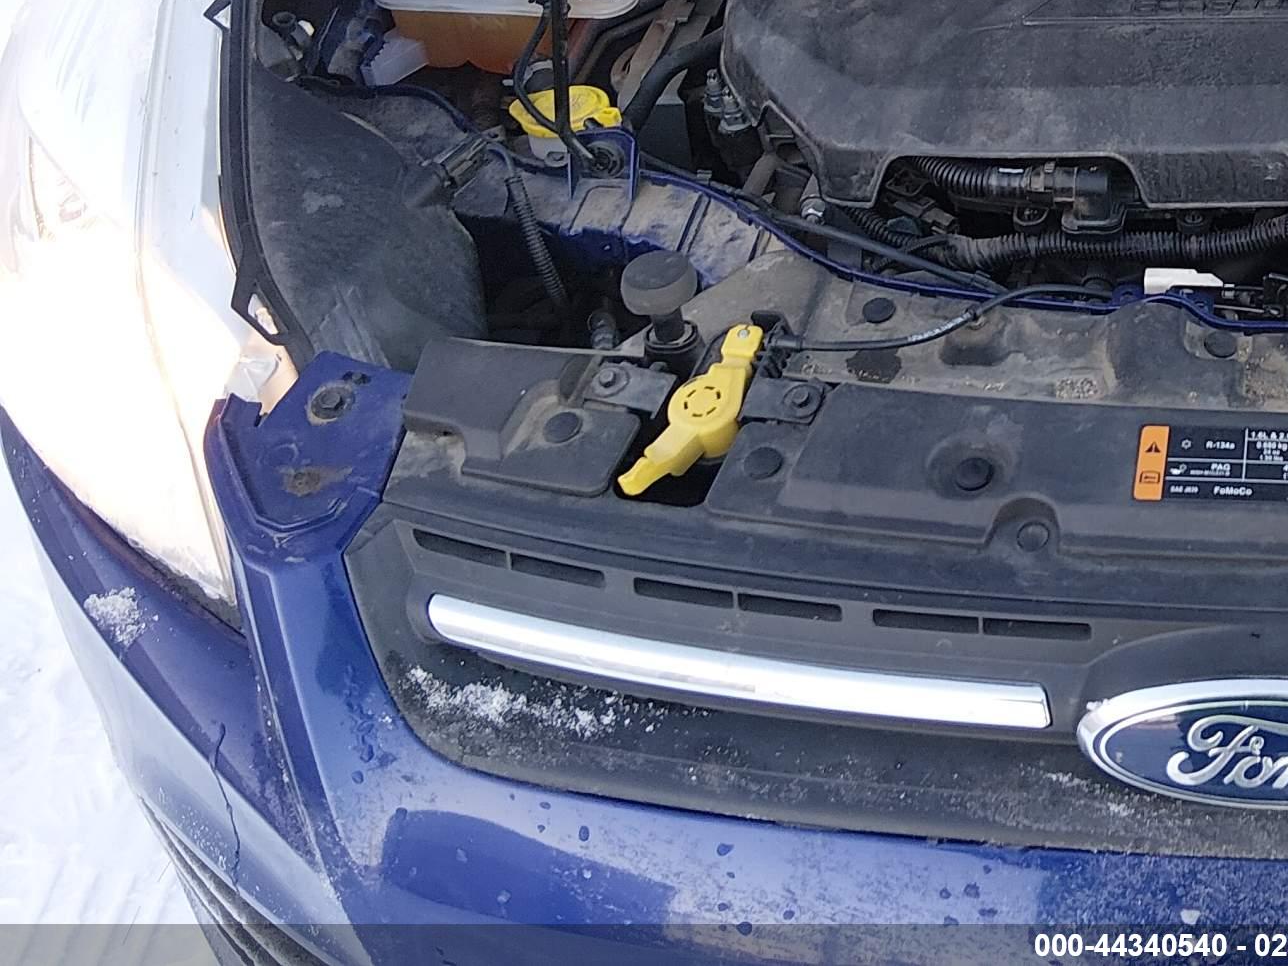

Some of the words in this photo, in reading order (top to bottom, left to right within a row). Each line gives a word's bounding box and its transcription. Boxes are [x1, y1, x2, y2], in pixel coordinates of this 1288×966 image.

[1205, 440, 1236, 450] R-134a
[1210, 463, 1231, 471] PAG
[1213, 486, 1253, 496] FoMoCo
